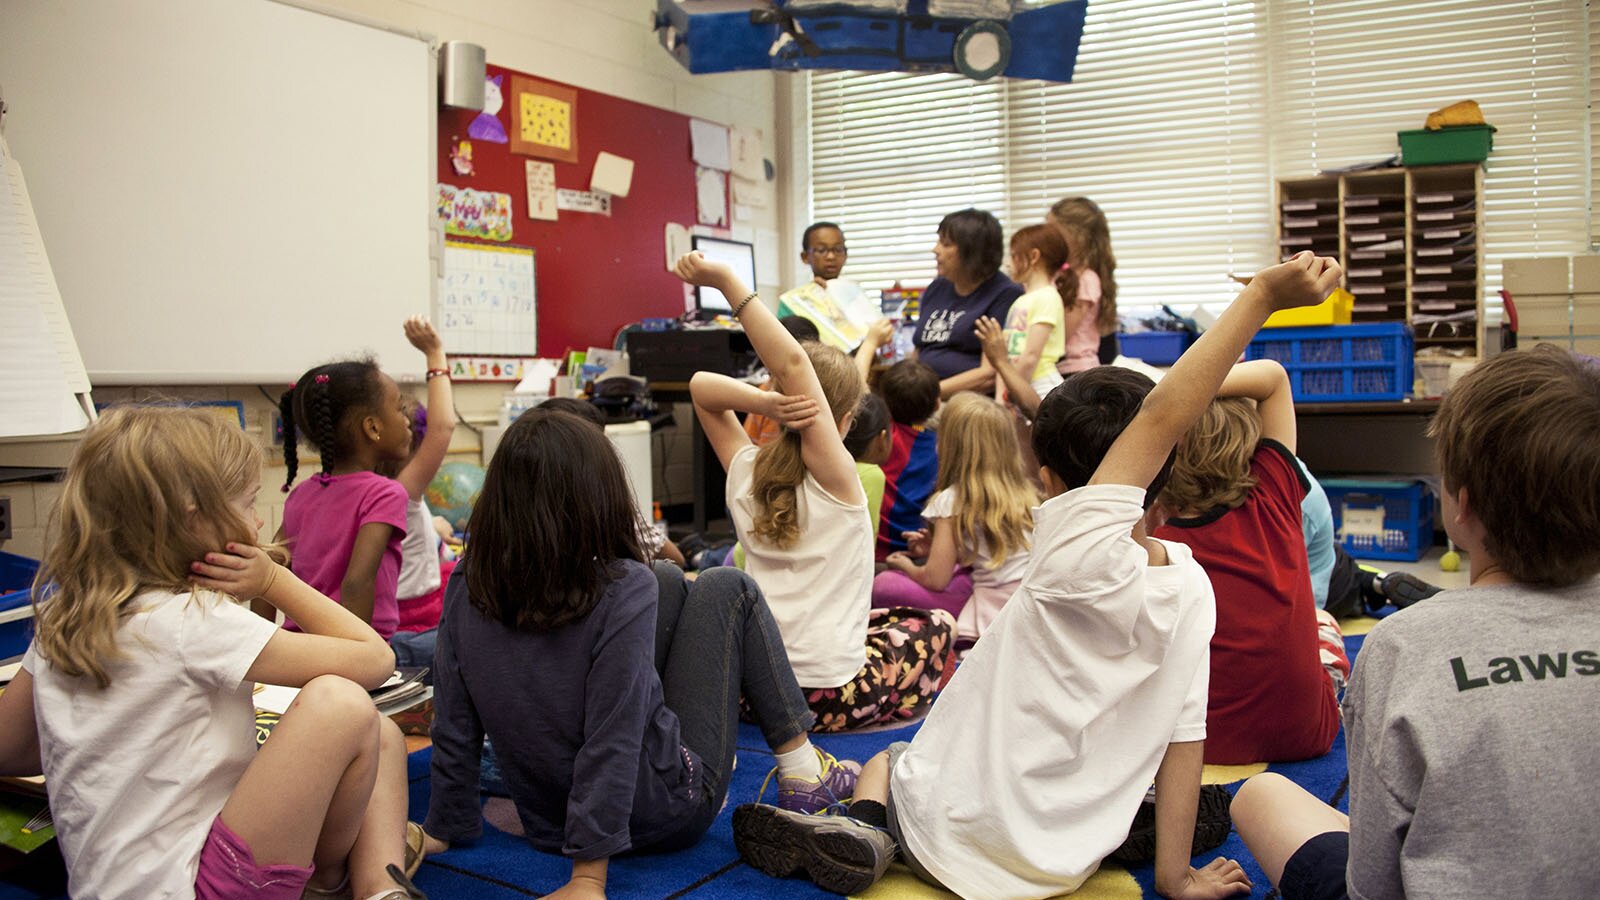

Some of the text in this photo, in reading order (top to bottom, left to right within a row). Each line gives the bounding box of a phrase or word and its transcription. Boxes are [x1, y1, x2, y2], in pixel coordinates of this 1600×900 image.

[453, 362, 465, 375] A
[504, 364, 513, 376] C
[1449, 650, 1600, 692] Laws
